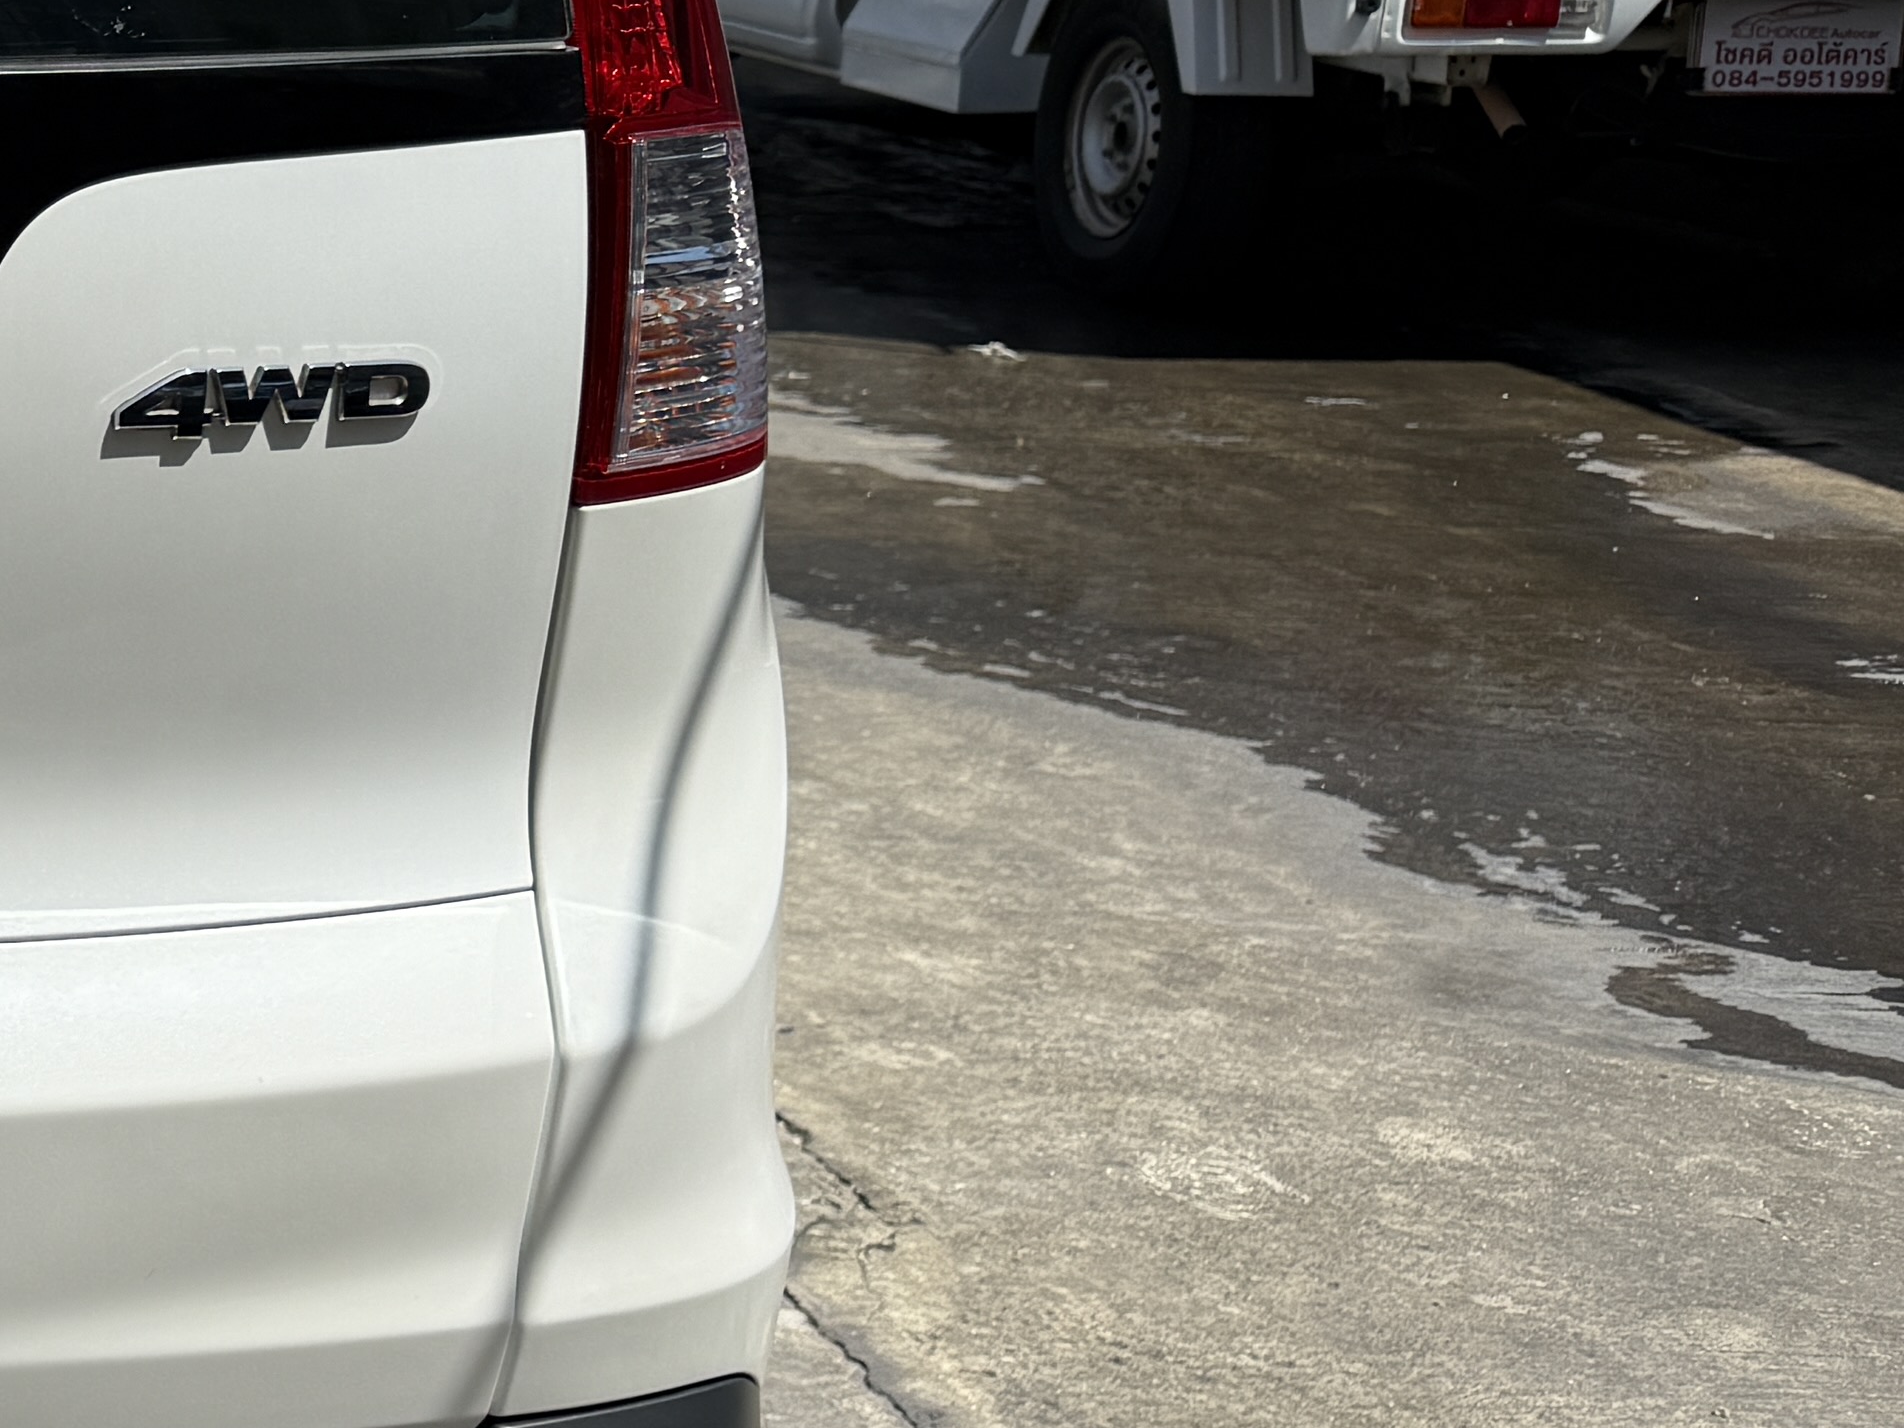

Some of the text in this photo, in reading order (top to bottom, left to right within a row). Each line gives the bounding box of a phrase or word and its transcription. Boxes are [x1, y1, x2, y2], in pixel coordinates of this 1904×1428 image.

[1756, 25, 1881, 39] CHOKDEE Autocar
[1715, 41, 1889, 66] โชคดี ออโต้คาร์
[1711, 70, 1885, 88] 084-5951999
[110, 358, 432, 441] 4WD
